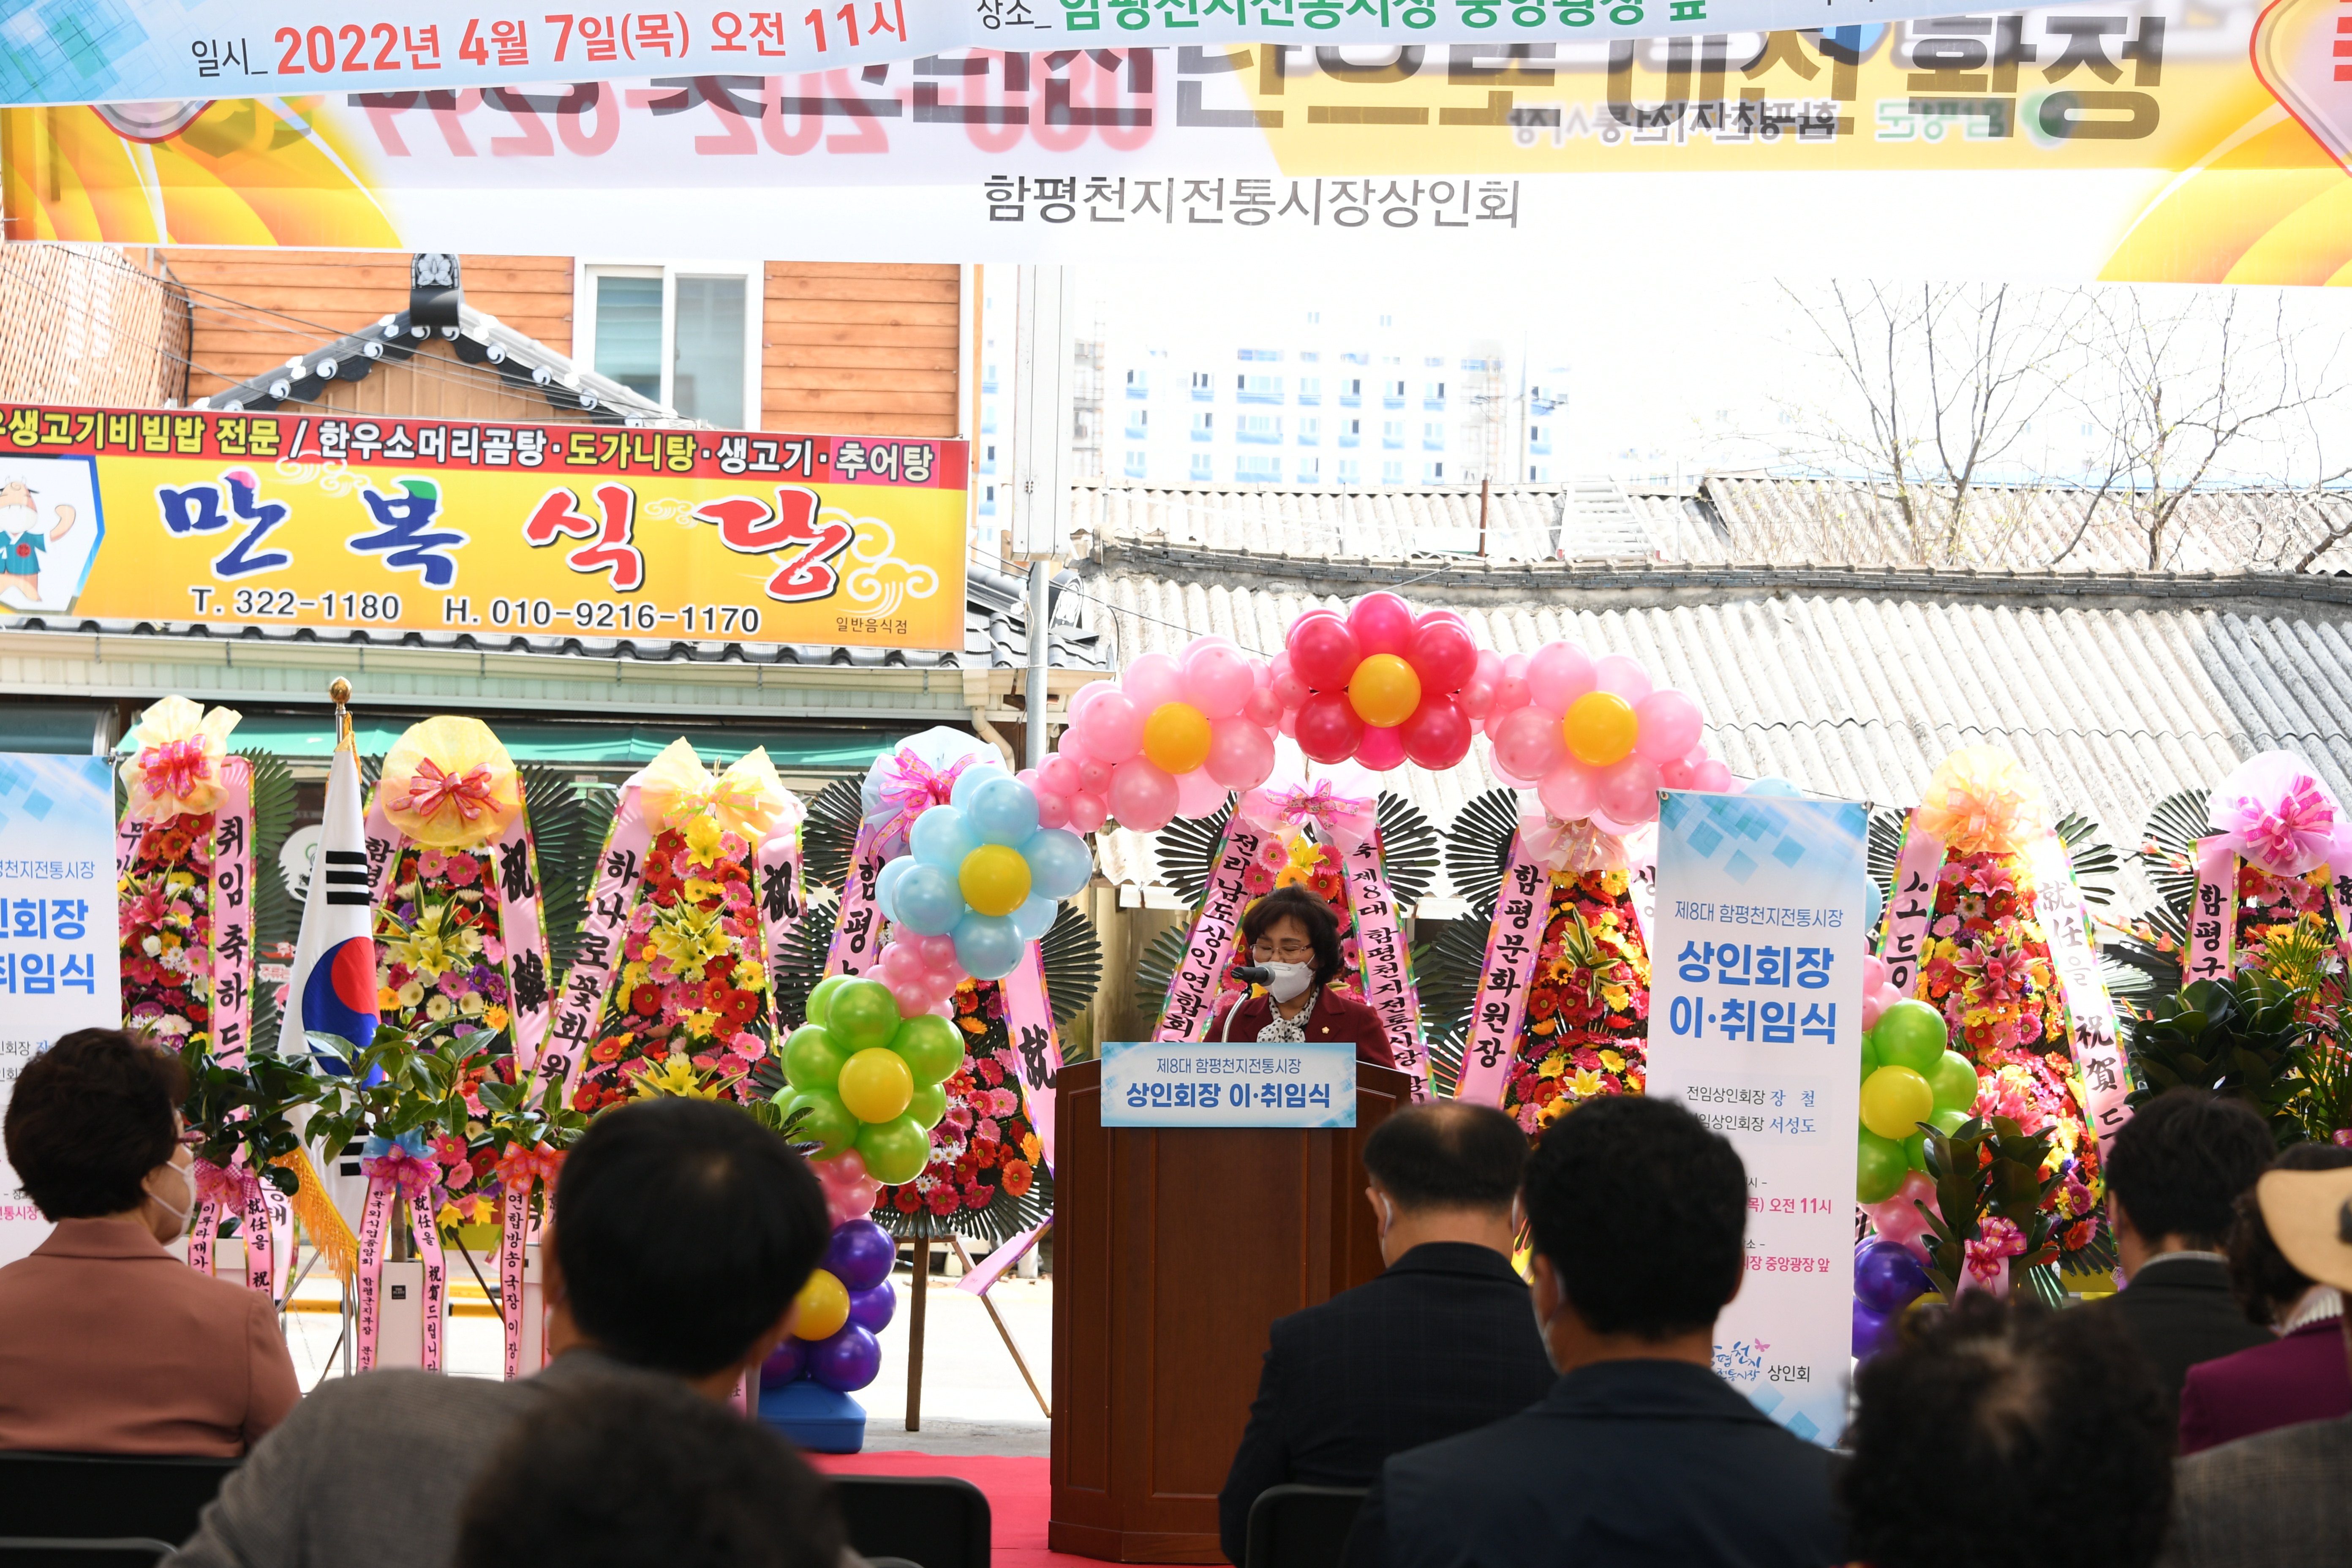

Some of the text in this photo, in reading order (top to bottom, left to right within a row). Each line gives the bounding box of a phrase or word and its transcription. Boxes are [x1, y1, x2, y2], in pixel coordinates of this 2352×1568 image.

[274, 23, 442, 75] 2022년
[458, 19, 529, 67] 4월
[544, 12, 690, 62] 7일(목)
[710, 11, 786, 57] 오전
[805, 0, 908, 53] 11시
[1907, 16, 2166, 139] 확정
[984, 174, 1520, 229] 함평천지전통시장상인회
[0, 412, 205, 453] 생고기비빔밥
[216, 418, 280, 456] 전문
[191, 588, 760, 633] T. 322-1180 H. 010-9216-1170
[836, 616, 908, 635] 일반음식점
[1351, 868, 1388, 917] 제8대
[1674, 901, 1844, 928] 제8대 함평천지전통시장
[216, 816, 248, 1061] 취임 축하드
[2037, 880, 2092, 986] 就任을
[1472, 863, 1544, 1068] 함평문화원장
[1677, 940, 1835, 989] 상인회장
[1364, 927, 1423, 1067] 함평천지전통시장
[1669, 996, 1837, 1045] 이·취임식
[1156, 1057, 1302, 1075] 제8대 함평천지전통시장
[1126, 1082, 1331, 1109] 상인회장 이·취임식
[1687, 1086, 1766, 1105] 전임상인회장
[1695, 1113, 1816, 1134] 임상인회장 서성도
[1745, 1176, 1757, 1188] 시
[413, 1195, 435, 1246] 就任을
[1769, 1198, 1795, 1214] 오전
[1800, 1198, 1832, 1214] 11시
[193, 1203, 215, 1272] 이루라재가
[505, 1192, 524, 1268] 연합방송
[1744, 1238, 1756, 1249] 소
[1765, 1256, 1815, 1273] 중앙광장
[1817, 1258, 1830, 1273] 앞
[504, 1274, 520, 1310] 국장
[1767, 1364, 1810, 1383] 상인회
